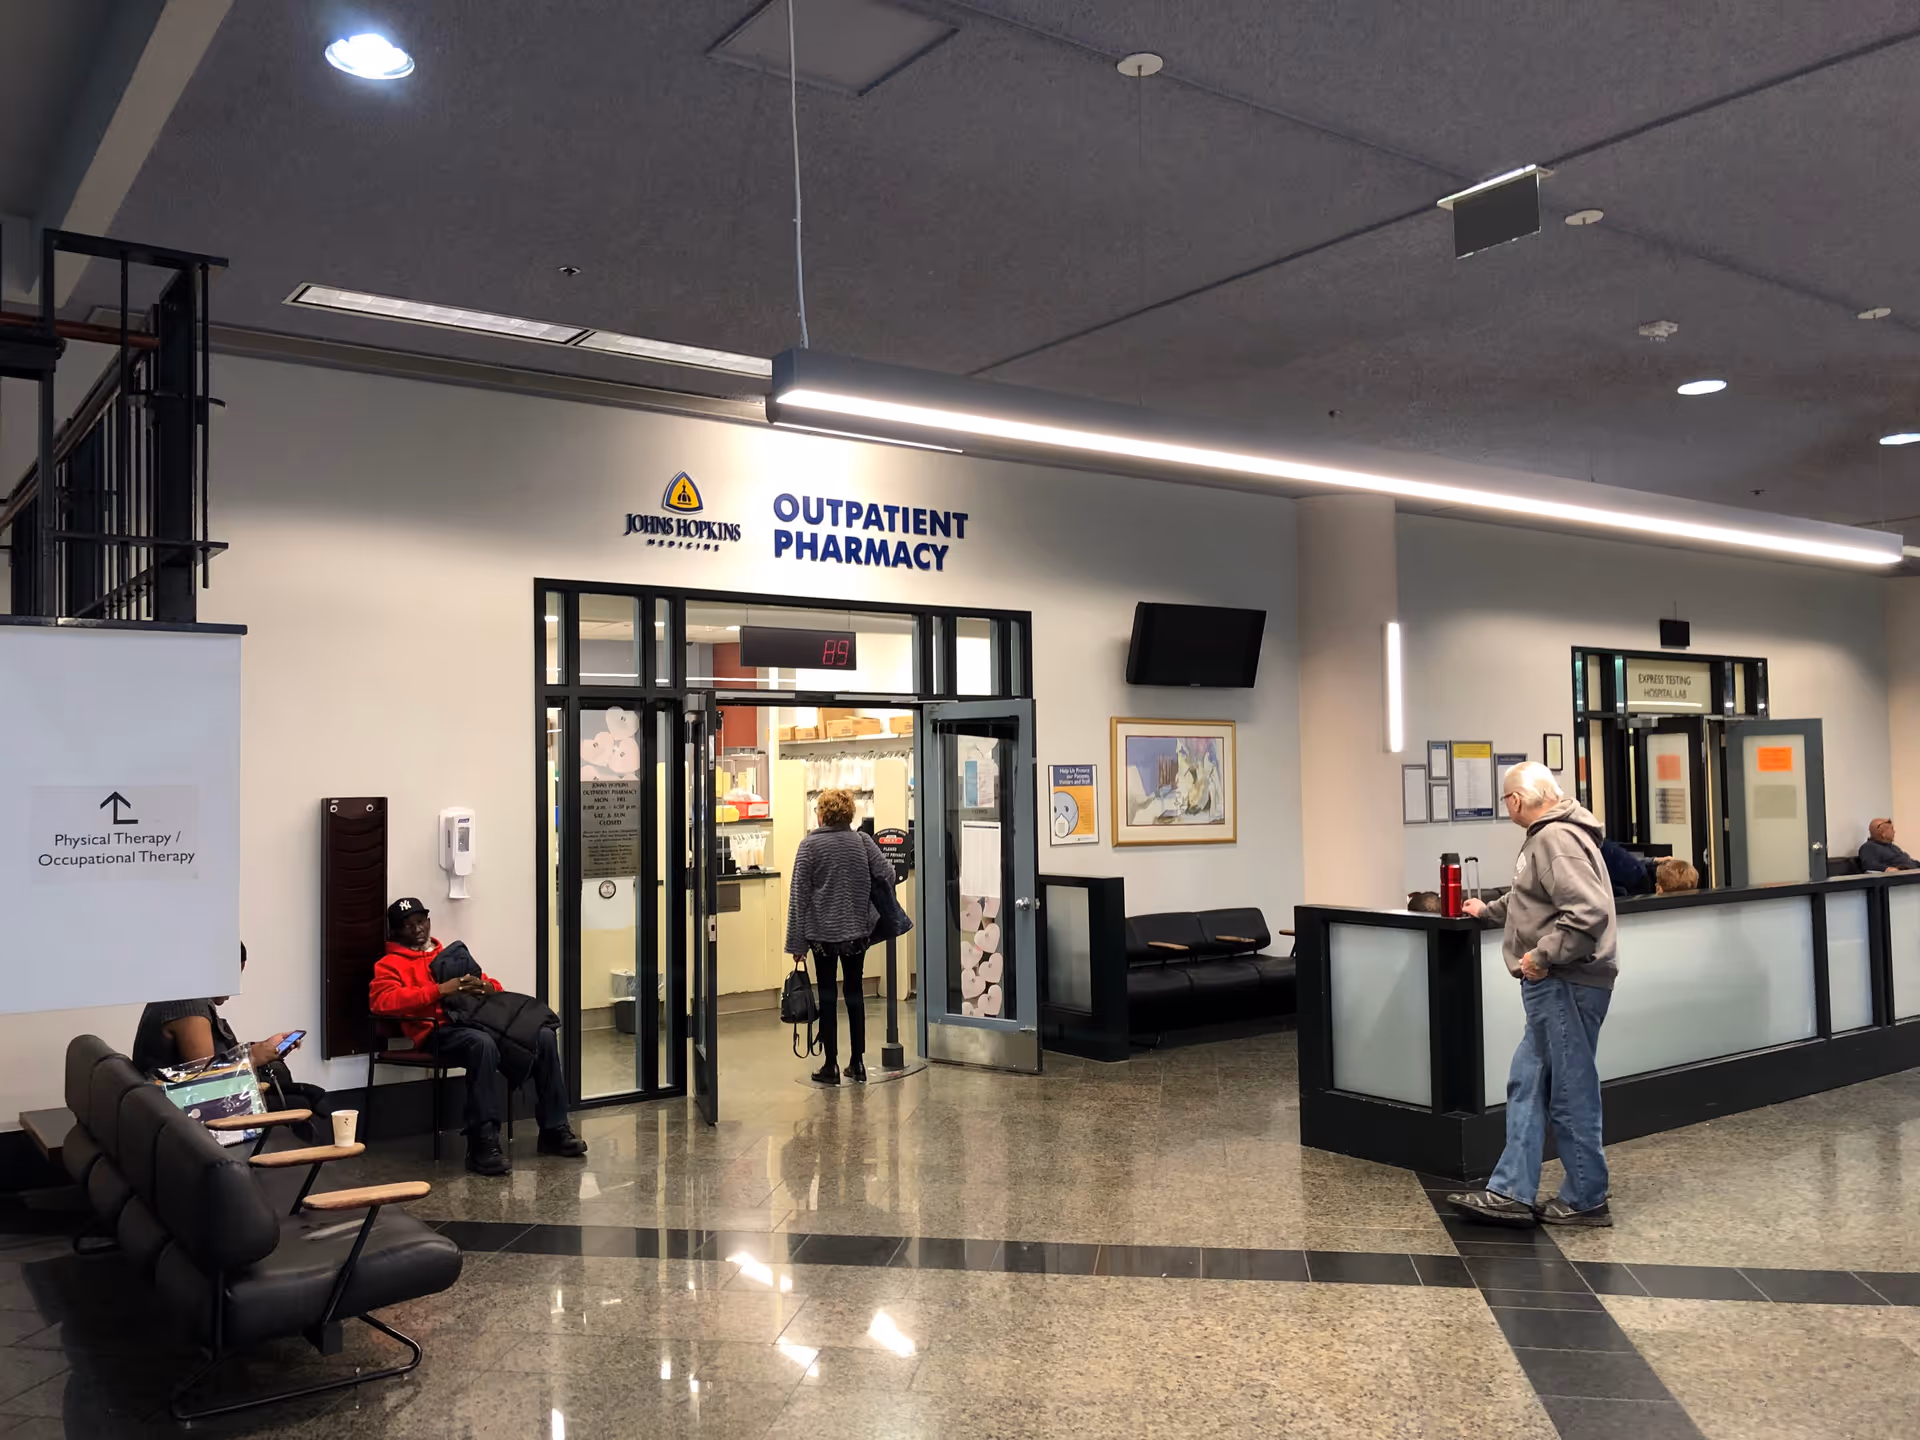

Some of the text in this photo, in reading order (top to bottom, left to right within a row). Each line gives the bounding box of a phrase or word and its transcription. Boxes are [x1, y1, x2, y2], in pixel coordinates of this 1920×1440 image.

[773, 493, 969, 539] OUTPATIENT
[623, 513, 741, 542] JOHNS HOPKINS
[647, 539, 720, 552] MEDICINE
[774, 529, 949, 572] PHARMACY
[1638, 673, 1692, 686] EXPRESS TESTING
[1643, 688, 1688, 699] HOSPITAL LAB
[54, 831, 181, 849] Physical Therapy /
[38, 850, 195, 868] Occupational Therapy
[399, 900, 412, 911] NY
